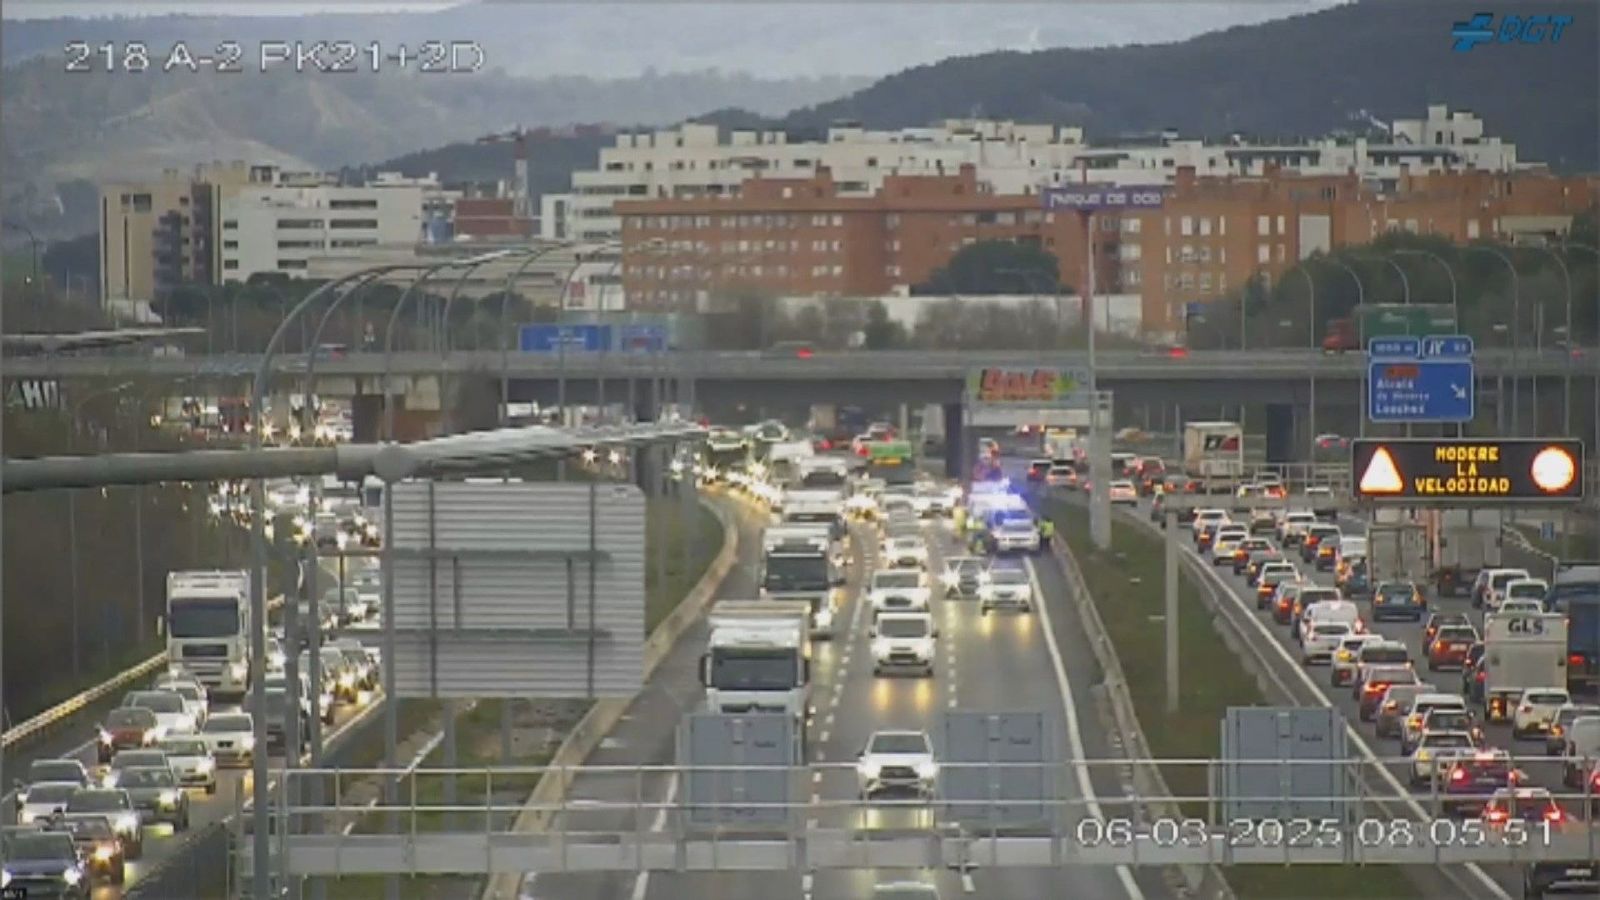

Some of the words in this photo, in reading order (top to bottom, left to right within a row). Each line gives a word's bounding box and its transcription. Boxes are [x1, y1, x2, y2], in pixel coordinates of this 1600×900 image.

[1435, 446, 1499, 461] MODERE
[1457, 463, 1478, 477] LA
[1414, 478, 1510, 493] VELOCIDAD
[1508, 618, 1543, 635] GLS
